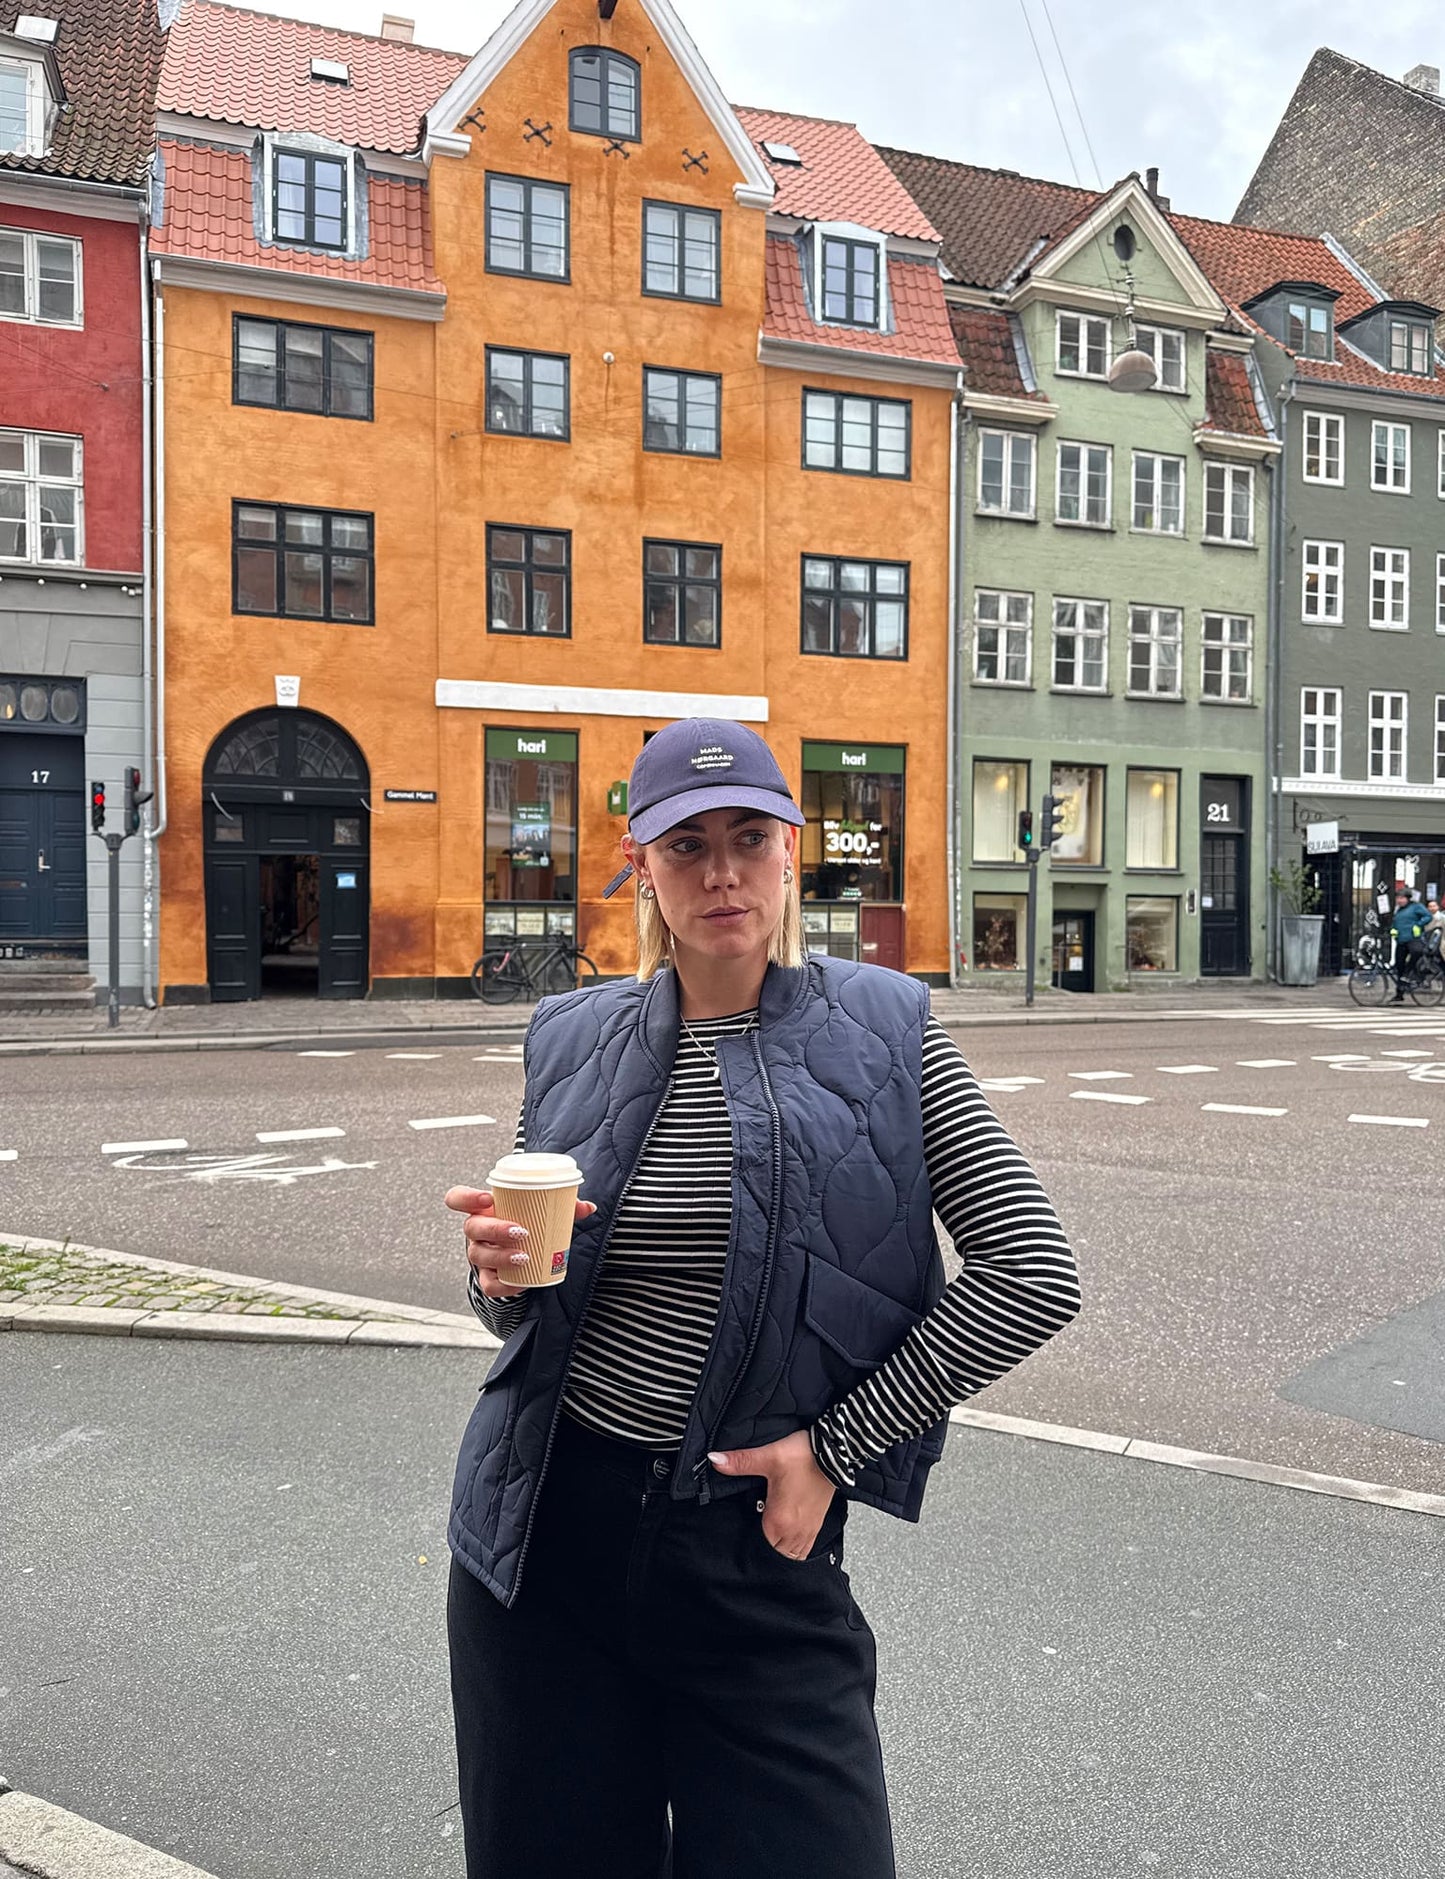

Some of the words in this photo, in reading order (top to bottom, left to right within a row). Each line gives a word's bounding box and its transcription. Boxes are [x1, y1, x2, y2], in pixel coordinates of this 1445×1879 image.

[517, 737, 547, 754] hari
[700, 746, 723, 754] MADS
[841, 751, 867, 766] hari
[31, 770, 50, 783] 17
[386, 790, 415, 799] Gammel
[1207, 802, 1230, 822] 21
[826, 832, 880, 855] 300,-
